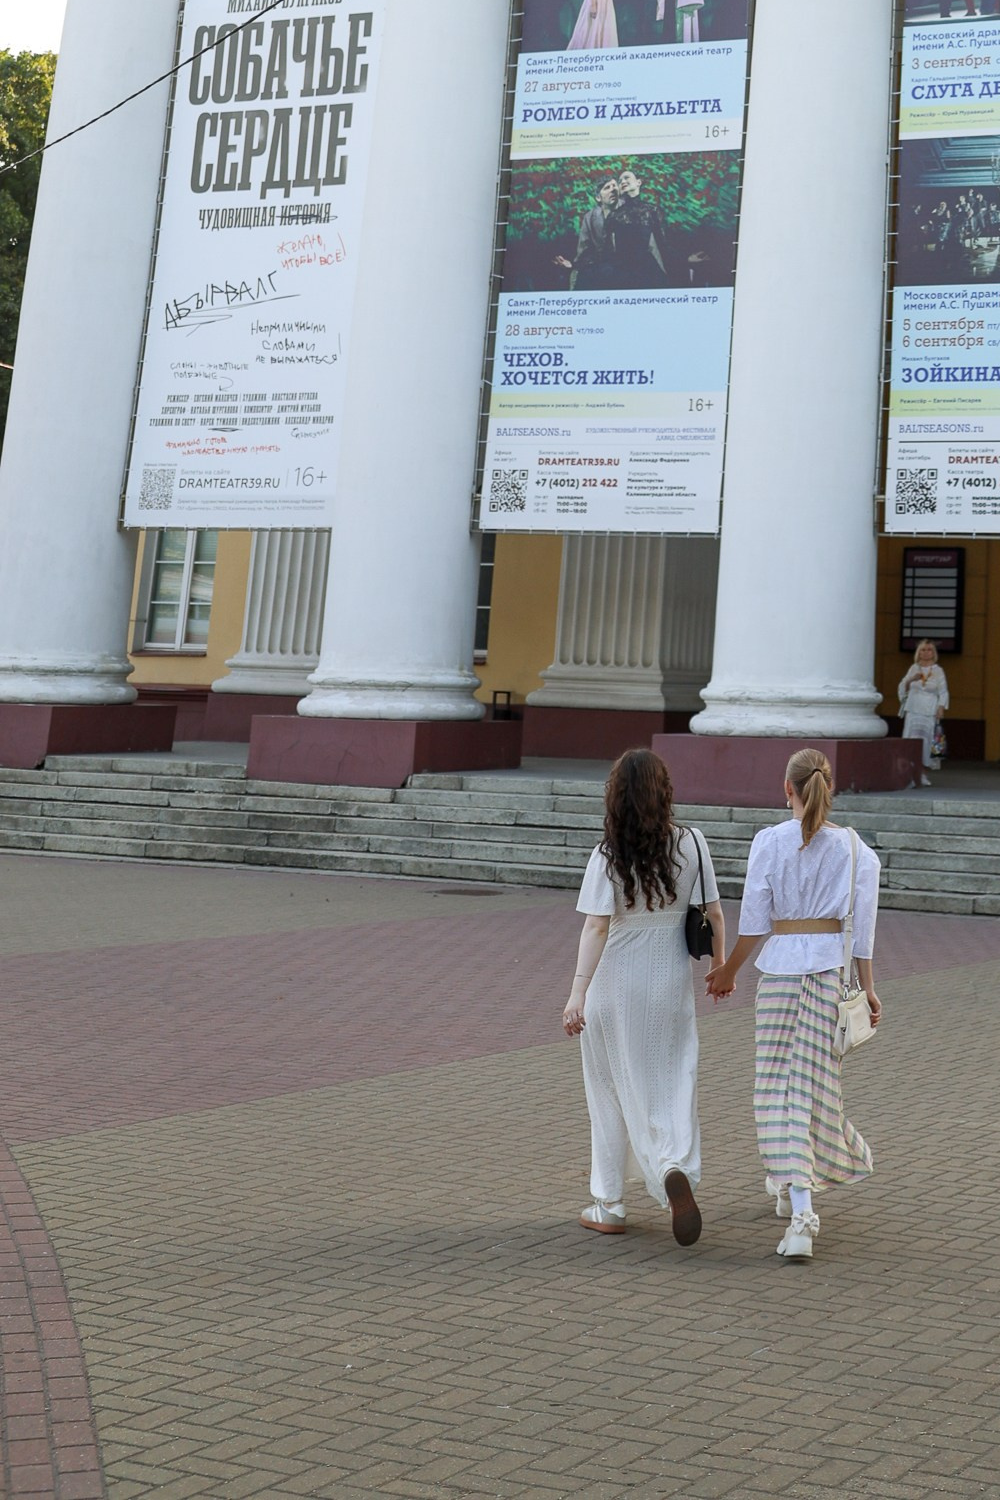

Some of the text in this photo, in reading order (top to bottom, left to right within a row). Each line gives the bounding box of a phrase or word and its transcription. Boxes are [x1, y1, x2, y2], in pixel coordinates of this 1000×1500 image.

[913, 29, 975, 42] Московский
[913, 42, 944, 50] имени
[947, 39, 967, 48] А.С.
[189, 12, 373, 105] СОБАЧЬЕ
[526, 47, 732, 67] Санкт-Петербургский академический театр
[911, 57, 920, 70] 3
[923, 54, 991, 68] сентября
[525, 64, 604, 75] имени Ленсовета
[524, 81, 539, 93] 27
[542, 79, 590, 93] августа
[911, 82, 974, 100] СЛУГА
[522, 99, 722, 122] РОМЕО И ДЖУЛЬЕТТА
[705, 125, 730, 138] 16+
[190, 103, 353, 199] СЕРДЦЕ
[199, 203, 331, 231] ЧУДОВИЩНАЯ ИСТОРИЯ
[165, 271, 277, 331] АБЫРВАЛГ
[507, 295, 718, 307] Санкт-Петербургский академический театр
[904, 289, 968, 300] Московский
[507, 307, 587, 317] имени Ленсовета
[903, 302, 937, 311] имени
[939, 301, 960, 310] А.С.
[505, 324, 520, 336] 28
[524, 325, 573, 338] августа
[903, 319, 911, 331] 5
[915, 317, 984, 332] сентября
[902, 335, 911, 347] 6
[914, 334, 984, 349] сентября
[503, 353, 568, 366] ЧЕХОВ.
[501, 370, 654, 386] ХОЧЕТСЯ ЖИТЬ!
[688, 399, 714, 411] 16+
[496, 428, 571, 437] BALTSEASONS.ru
[899, 424, 984, 434] BALTSEASONS.ru
[538, 458, 620, 466] DRAMTEATR39.RU
[179, 467, 327, 489] DRAMTEATR39.RU 16+
